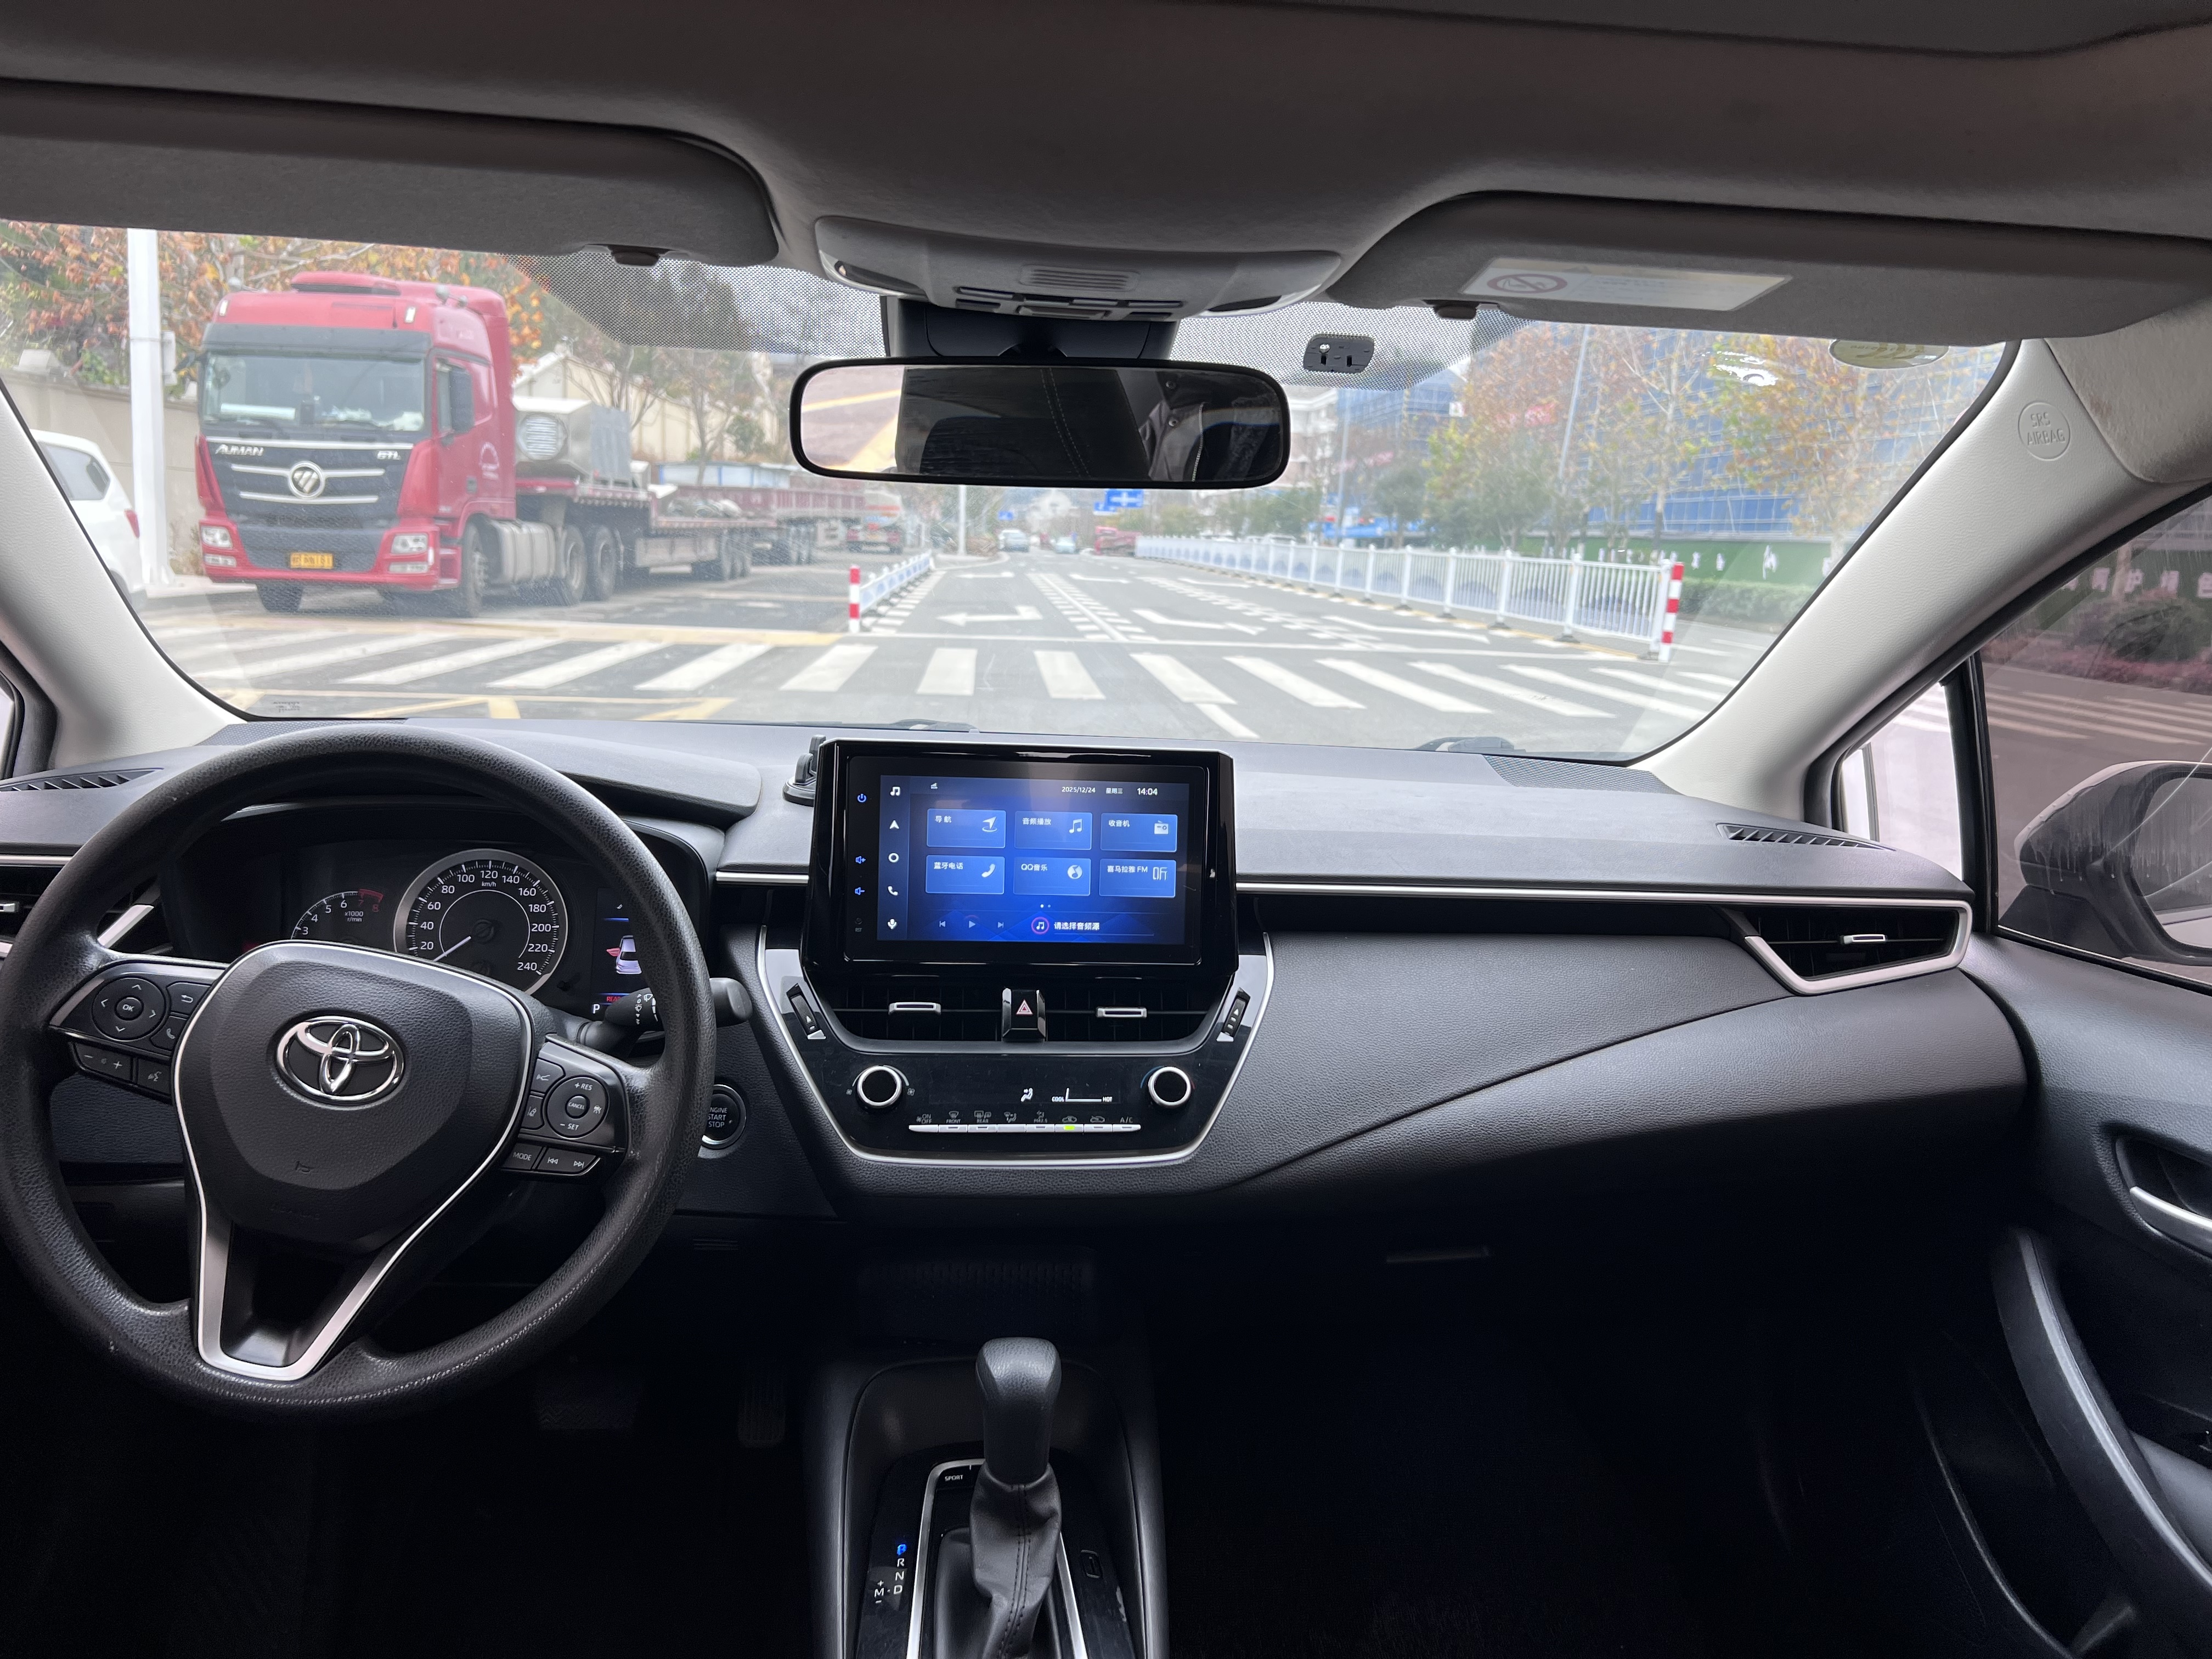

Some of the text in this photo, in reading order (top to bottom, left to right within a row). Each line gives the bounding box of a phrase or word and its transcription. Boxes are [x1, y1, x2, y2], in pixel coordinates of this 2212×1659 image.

[2030, 412, 2051, 428] SRS
[2027, 428, 2066, 445] AIRBAG
[1023, 817, 1052, 826] 音频播放
[1021, 864, 1048, 872] QQ音乐
[1107, 865, 1136, 873] 喜马拉雅
[457, 874, 475, 883] 100
[480, 870, 498, 878] 120
[502, 876, 520, 884] 140
[441, 885, 455, 894] 80
[518, 888, 537, 896] 160
[340, 900, 347, 908] 6
[373, 904, 380, 912] 8
[427, 901, 441, 910] 60
[528, 904, 546, 912] 180
[325, 905, 332, 913] 5
[311, 914, 318, 923] 4
[420, 921, 434, 930] 40
[531, 923, 551, 932] 200
[1054, 922, 1100, 931] 请选择音频源
[302, 926, 309, 935] 3
[420, 941, 434, 950] 20
[528, 944, 548, 952] 220
[517, 962, 537, 970] 240
[592, 1003, 600, 1014] P
[513, 1152, 532, 1161] MODE
[896, 1544, 907, 1555] P
[897, 1558, 905, 1567] R
[895, 1571, 905, 1581] N
[874, 1587, 884, 1598] M
[893, 1584, 903, 1595] D
